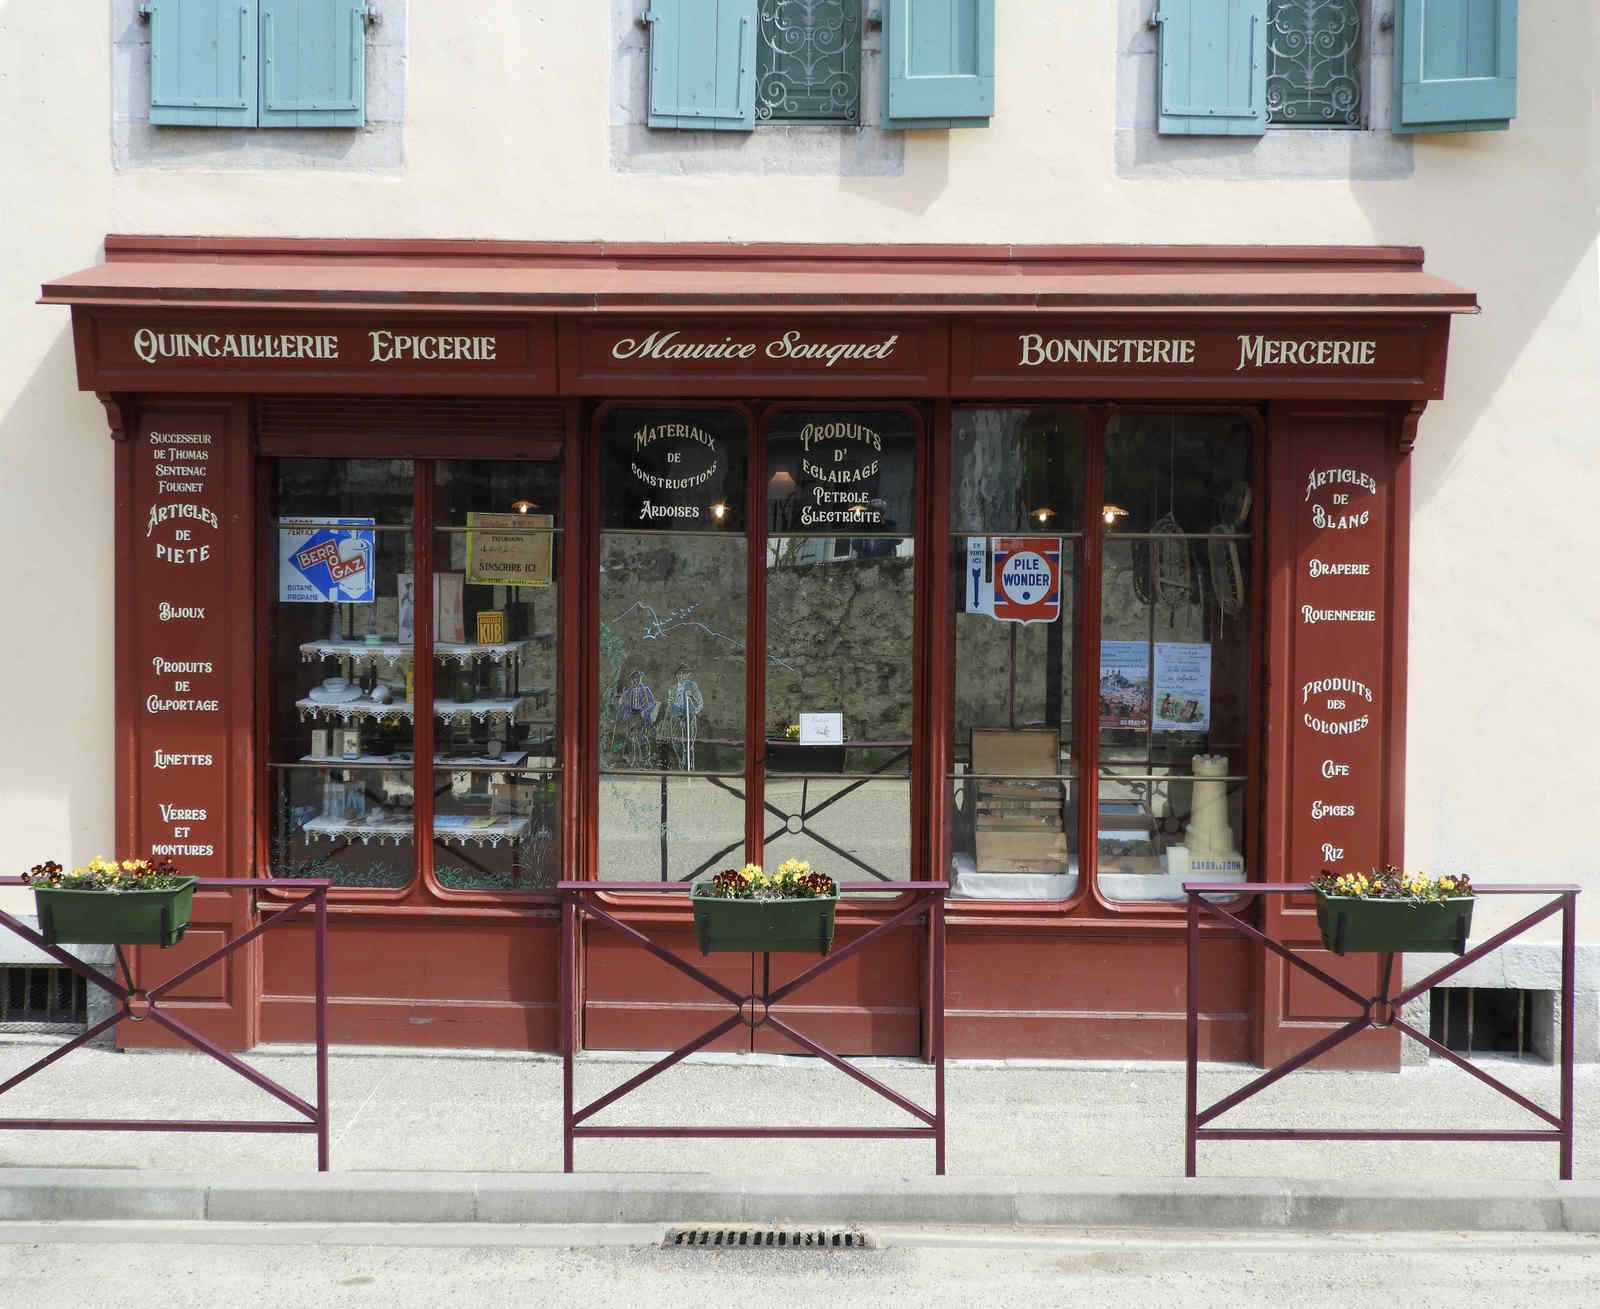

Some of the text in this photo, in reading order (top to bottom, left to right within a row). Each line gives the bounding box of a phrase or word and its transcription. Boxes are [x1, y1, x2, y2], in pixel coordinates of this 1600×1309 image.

[135, 329, 496, 363] QUINCAILLERIE EPICERIE
[612, 331, 898, 366] Maurice Souquet
[1019, 334, 1376, 370] BONNETERIE MERCERIE
[151, 432, 211, 444] SUCCESSEUR
[634, 424, 715, 452] MATERIAUX
[801, 423, 881, 452] PRODUITS
[154, 448, 208, 461] DE THOMAS
[668, 453, 680, 462] DE
[835, 448, 847, 461] D'
[156, 464, 206, 476] SENTENAC
[632, 458, 716, 489] CONSTRUCTIONS
[803, 458, 878, 482] ECLAIRAGE
[159, 481, 203, 493] FOUGNET
[1305, 469, 1376, 502] ARTICLES
[813, 487, 870, 505] PETROLE
[1334, 494, 1348, 504] DE
[640, 501, 699, 519] ARDOISES
[801, 504, 880, 524] ELECTRICITE
[1313, 503, 1368, 529] BLANC
[147, 504, 217, 539] ARTICLES
[176, 530, 190, 540] DE
[157, 544, 209, 563] PIETE
[332, 559, 364, 579] GAZ
[1014, 558, 1040, 570] PILE
[1310, 559, 1369, 577] DRAPERIE
[1003, 573, 1050, 586] WONDER
[159, 602, 204, 621] BIJOUX
[1302, 605, 1375, 623] ROUENNERIE
[480, 624, 501, 643] KUB
[153, 657, 212, 675] PRODUITS
[176, 681, 190, 691] DE
[1303, 678, 1372, 705] PRODUITS
[147, 695, 218, 713] COLPORTAGE
[1328, 700, 1345, 709] DES
[1304, 714, 1368, 734] COLONIES
[154, 749, 212, 769] LUNETTES
[1322, 760, 1349, 778] CAFE
[159, 804, 206, 822] VERRES
[1312, 801, 1354, 819] EPICES
[175, 827, 190, 837] ET
[1322, 843, 1343, 861] RIZ
